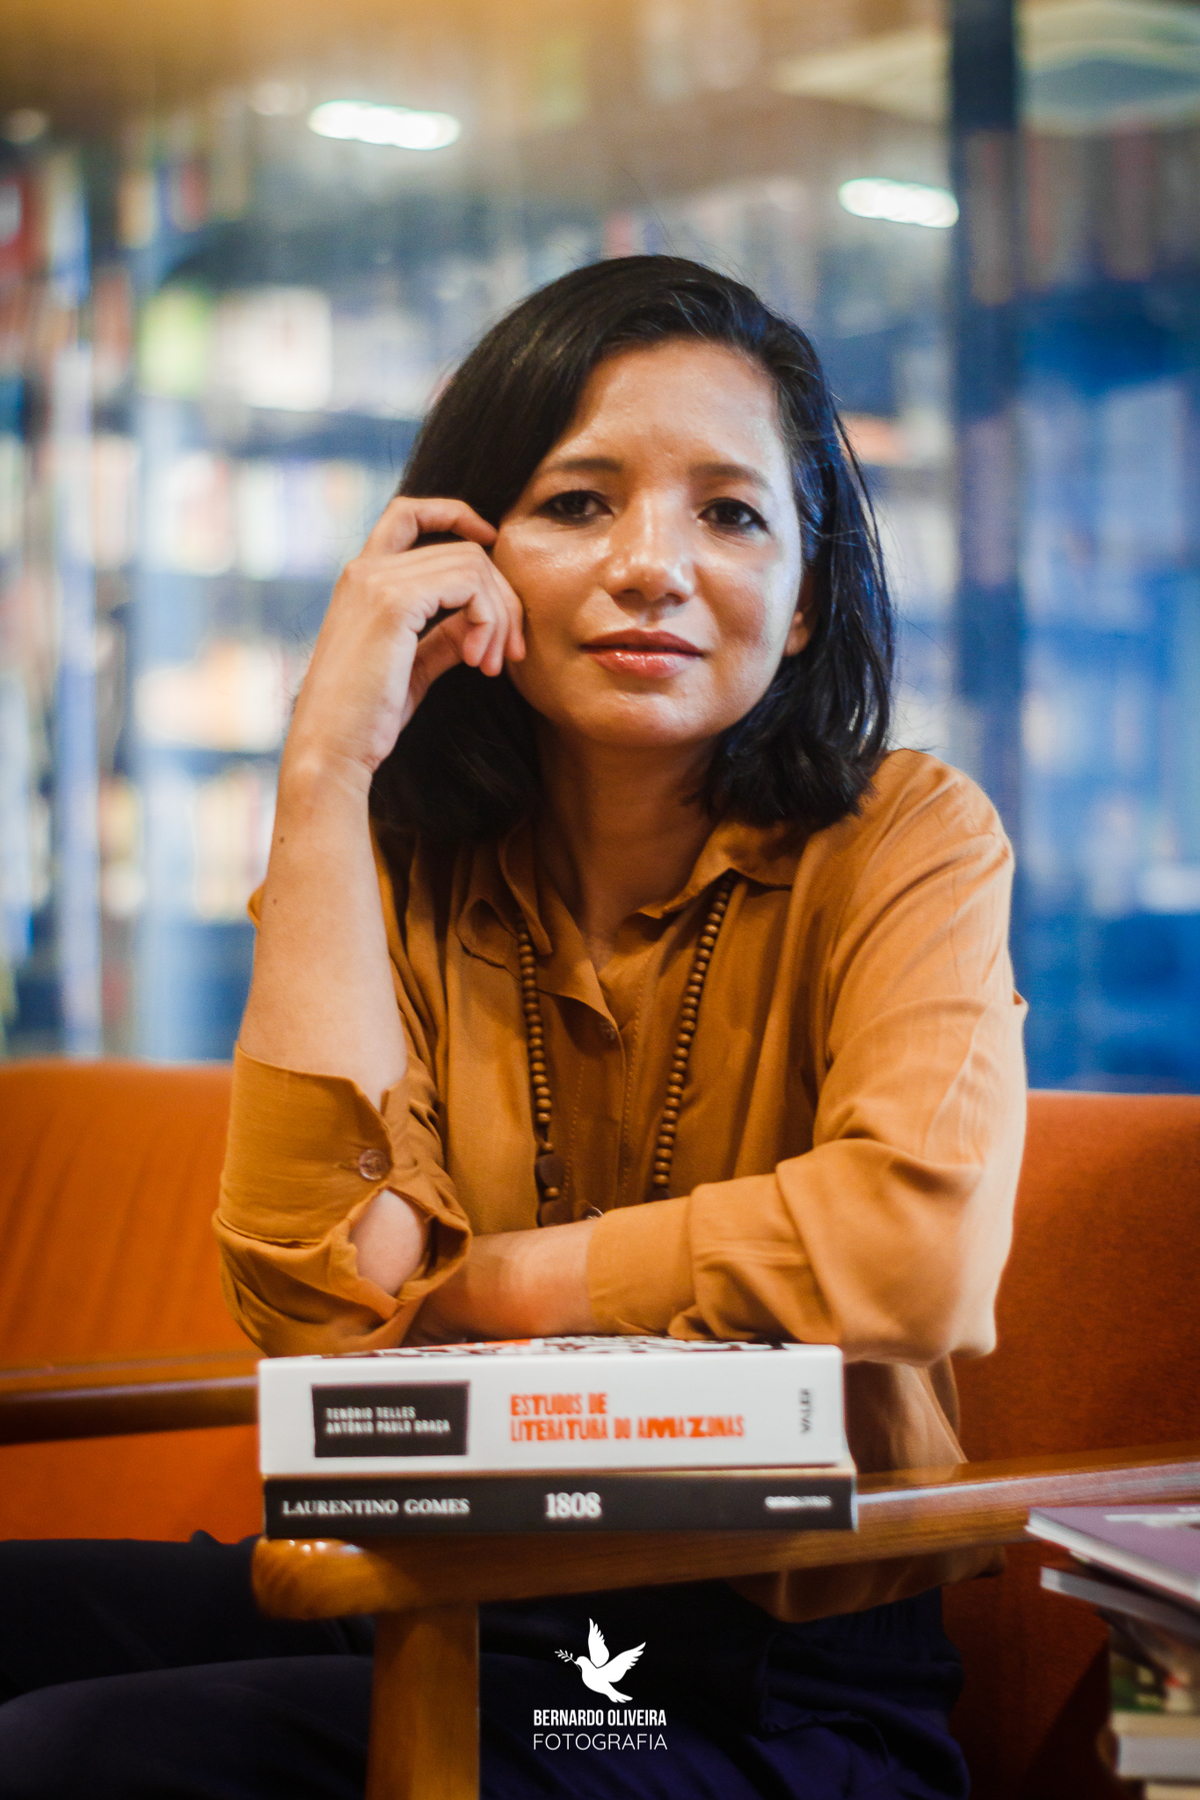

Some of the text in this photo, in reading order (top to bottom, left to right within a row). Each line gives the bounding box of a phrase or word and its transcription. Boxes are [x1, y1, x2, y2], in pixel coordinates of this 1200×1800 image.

[376, 1405, 417, 1420] TELLES
[588, 1392, 608, 1415] DE
[376, 1420, 412, 1433] PAULO
[509, 1418, 609, 1442] LITERATURA
[637, 1415, 745, 1439] AMAZONAS
[283, 1498, 470, 1516] LAURENTINO GOMES
[546, 1492, 602, 1519] 1808
